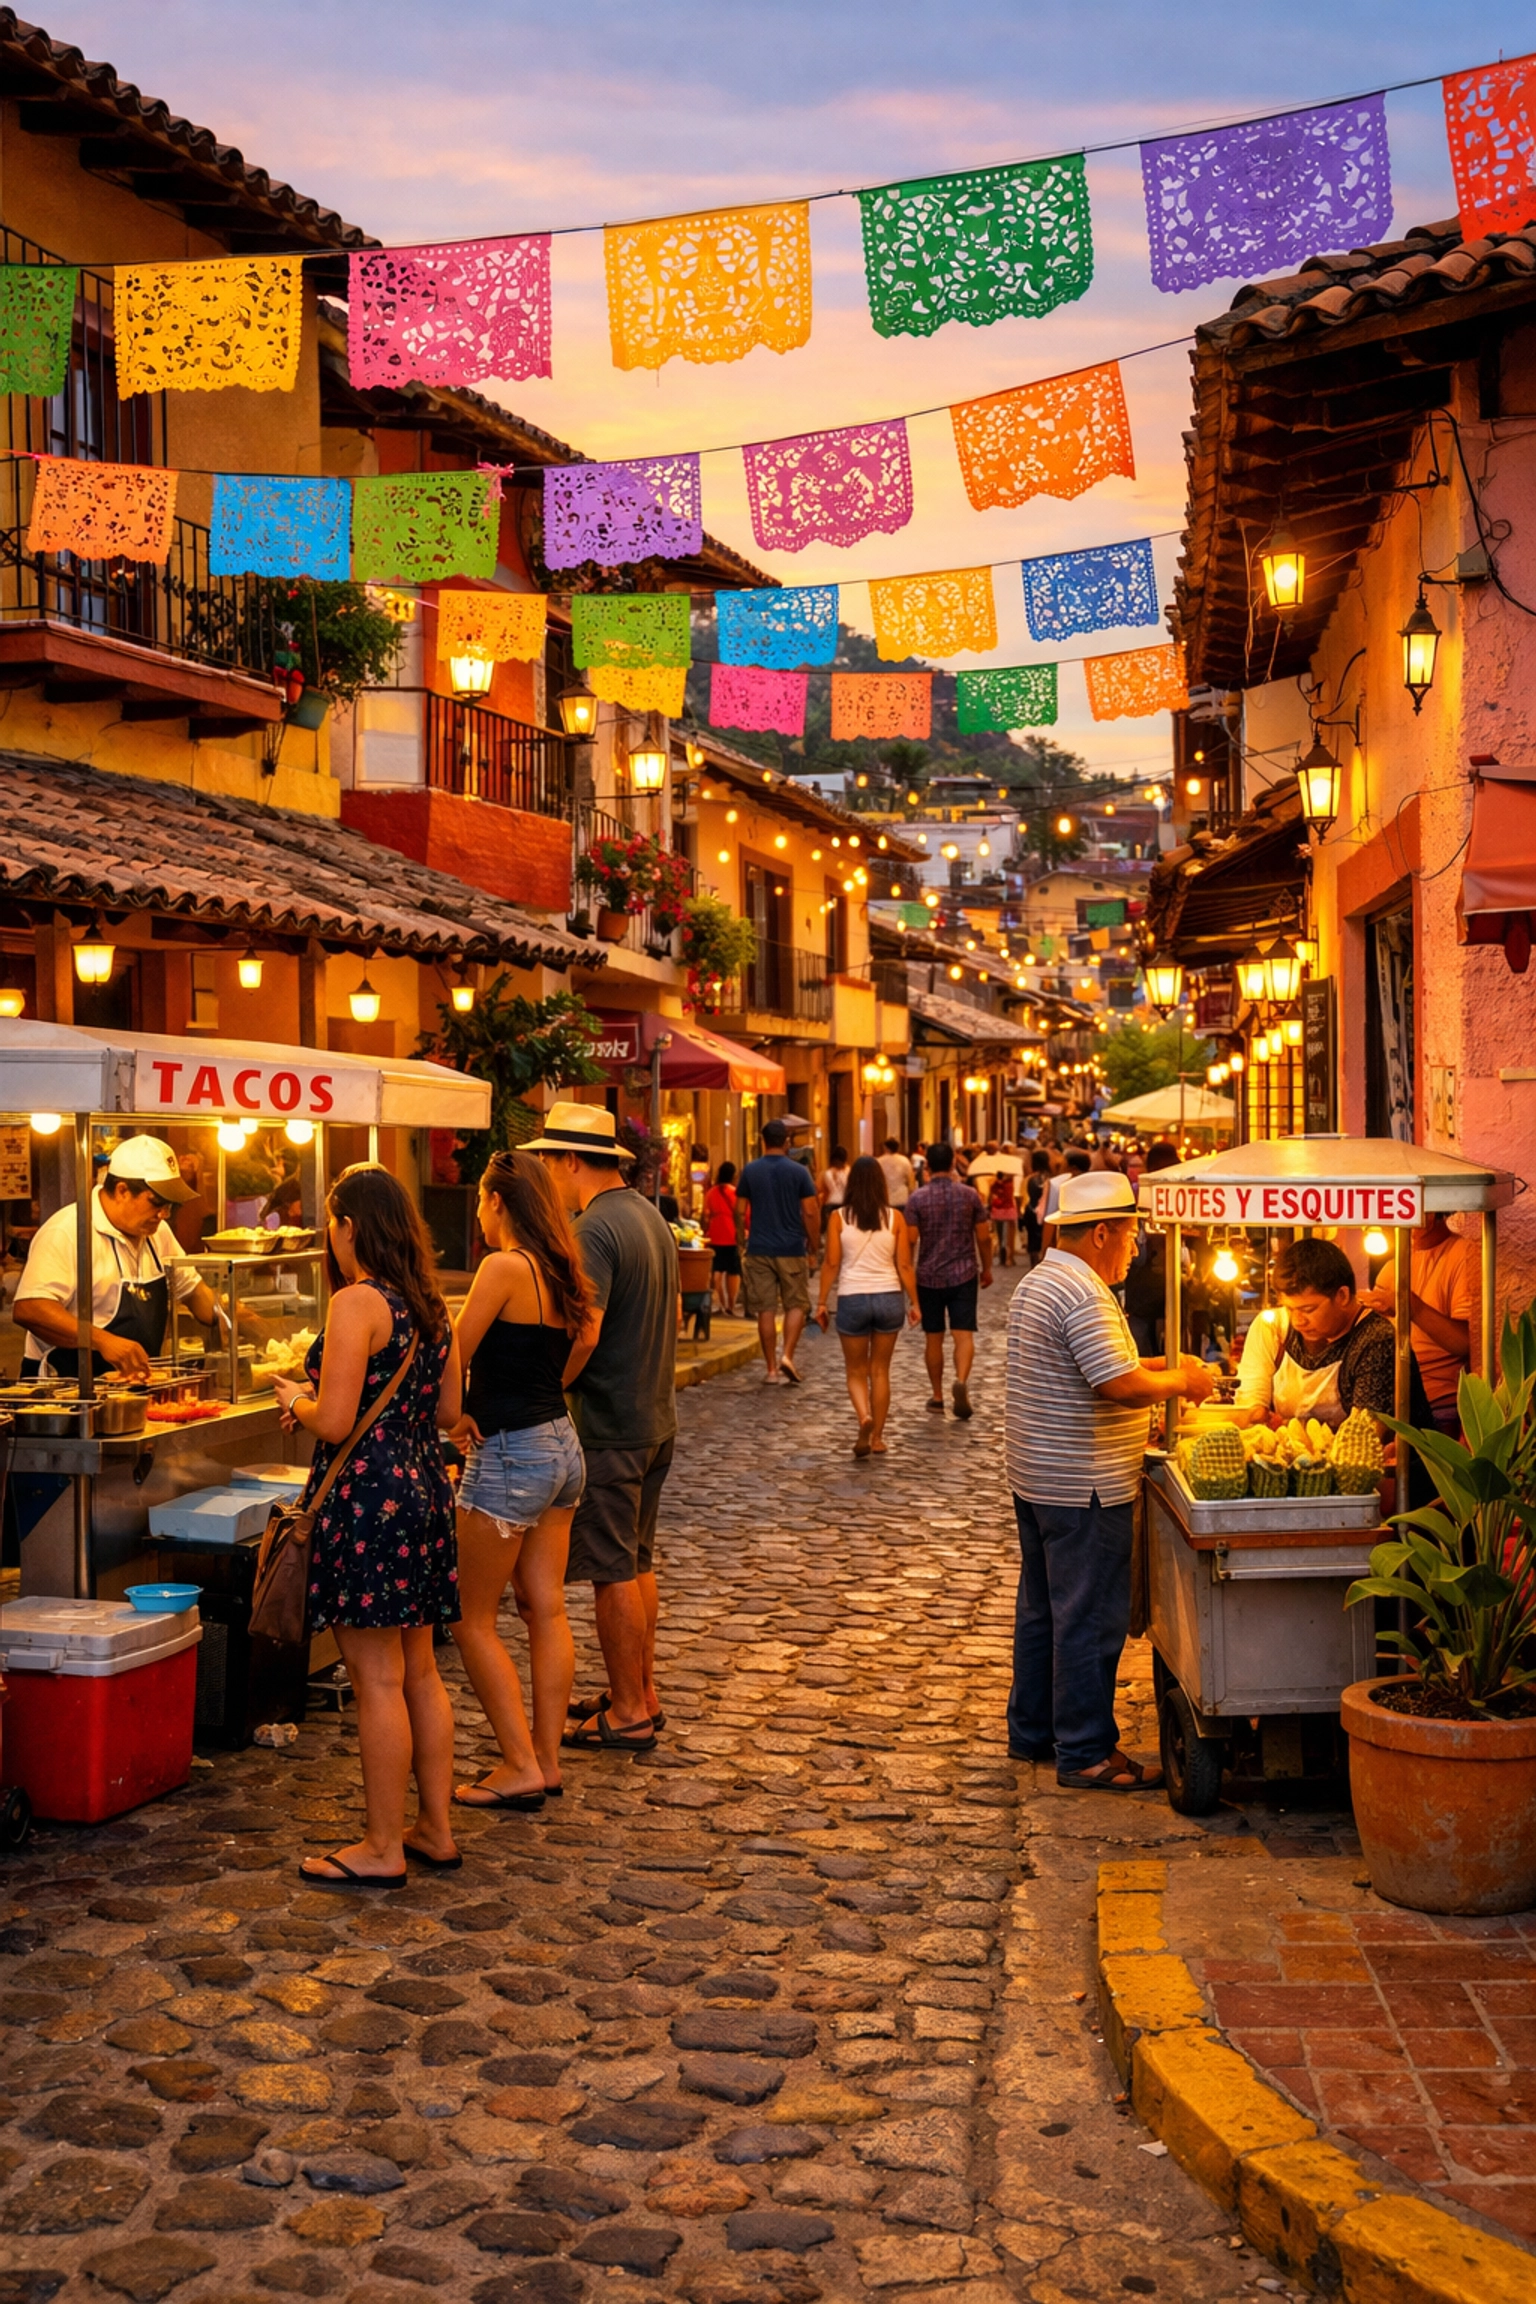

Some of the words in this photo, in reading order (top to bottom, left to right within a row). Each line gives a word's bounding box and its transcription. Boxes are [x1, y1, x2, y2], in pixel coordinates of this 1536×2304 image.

[152, 1061, 333, 1113] TACOS
[1155, 1187, 1225, 1218] ELOTES
[1236, 1188, 1252, 1218] Y
[1263, 1188, 1416, 1222] ESQUITES
